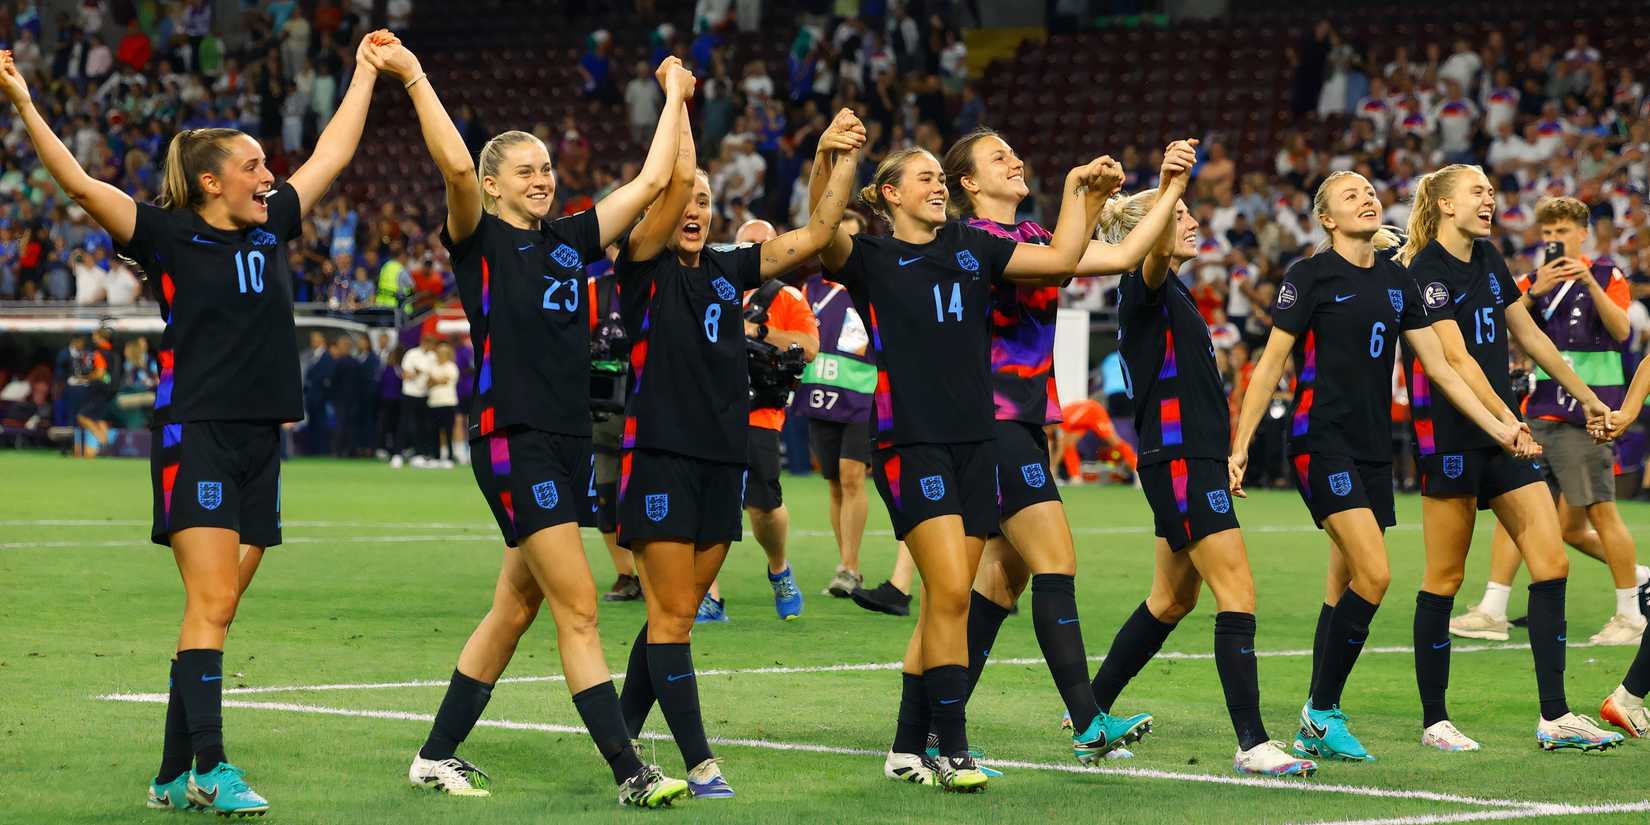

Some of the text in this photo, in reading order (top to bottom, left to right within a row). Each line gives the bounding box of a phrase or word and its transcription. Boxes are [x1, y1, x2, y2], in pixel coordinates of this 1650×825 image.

[234, 250, 265, 293] 10
[543, 275, 579, 312] 23
[933, 282, 963, 322] 14
[704, 303, 721, 343] 8
[1370, 322, 1385, 358] 6
[1475, 307, 1495, 344] 15
